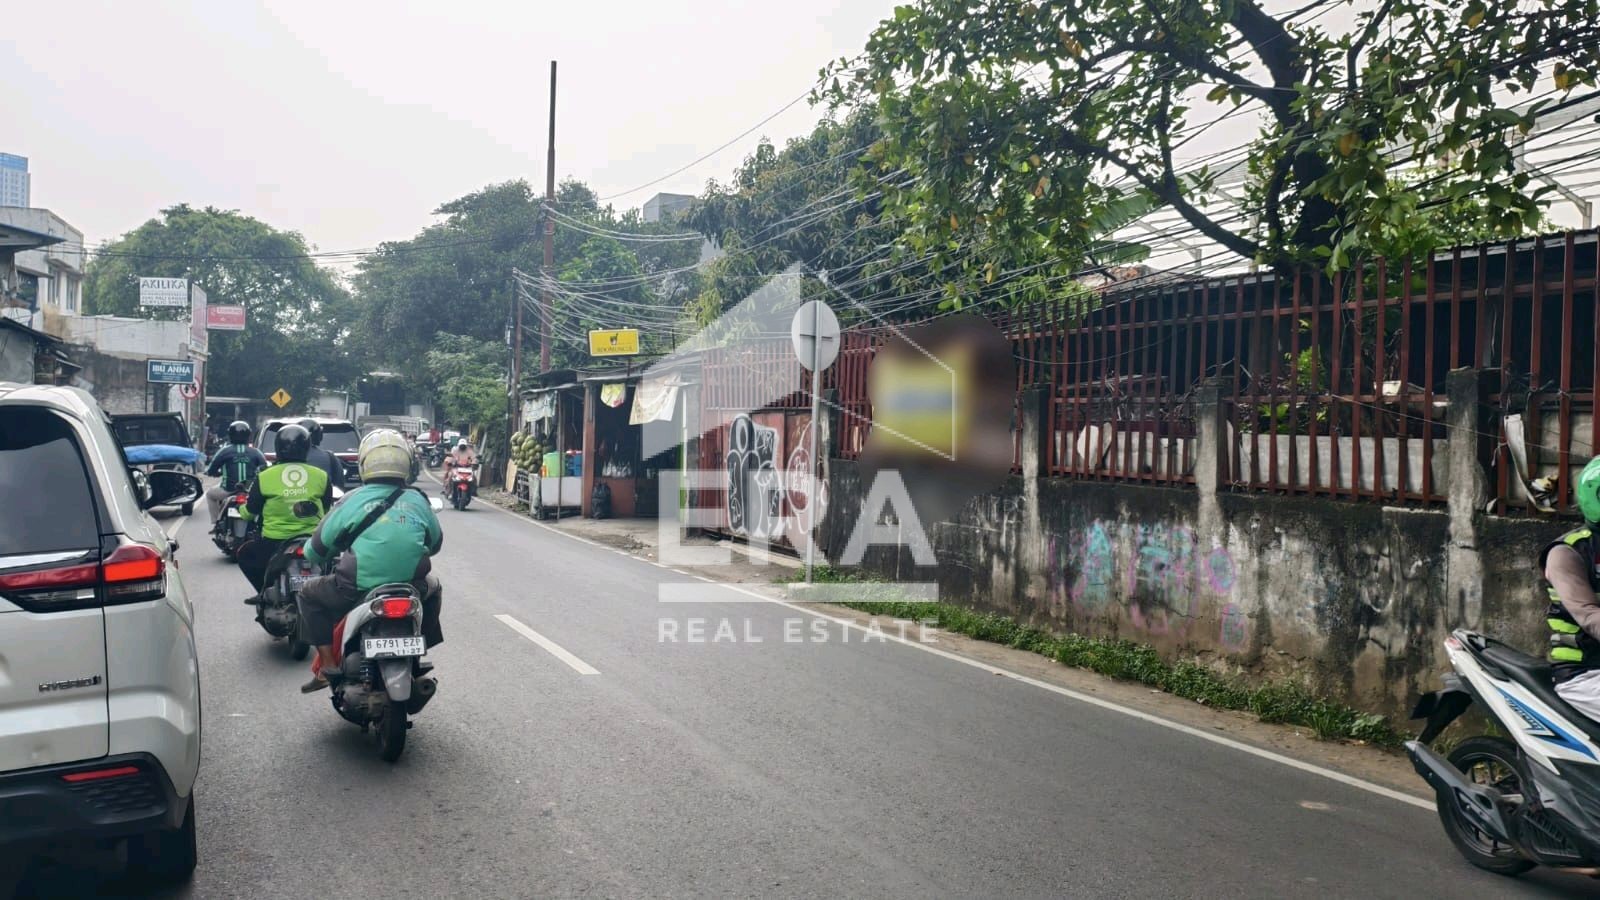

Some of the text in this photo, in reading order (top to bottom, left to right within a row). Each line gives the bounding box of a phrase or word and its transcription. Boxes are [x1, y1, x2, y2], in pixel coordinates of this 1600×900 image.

[142, 279, 186, 289] AKILIKA
[152, 364, 166, 372] IBU
[167, 365, 191, 374] ANNA
[283, 486, 309, 497] gojek
[366, 640, 372, 650] B
[376, 639, 399, 649] 6791
